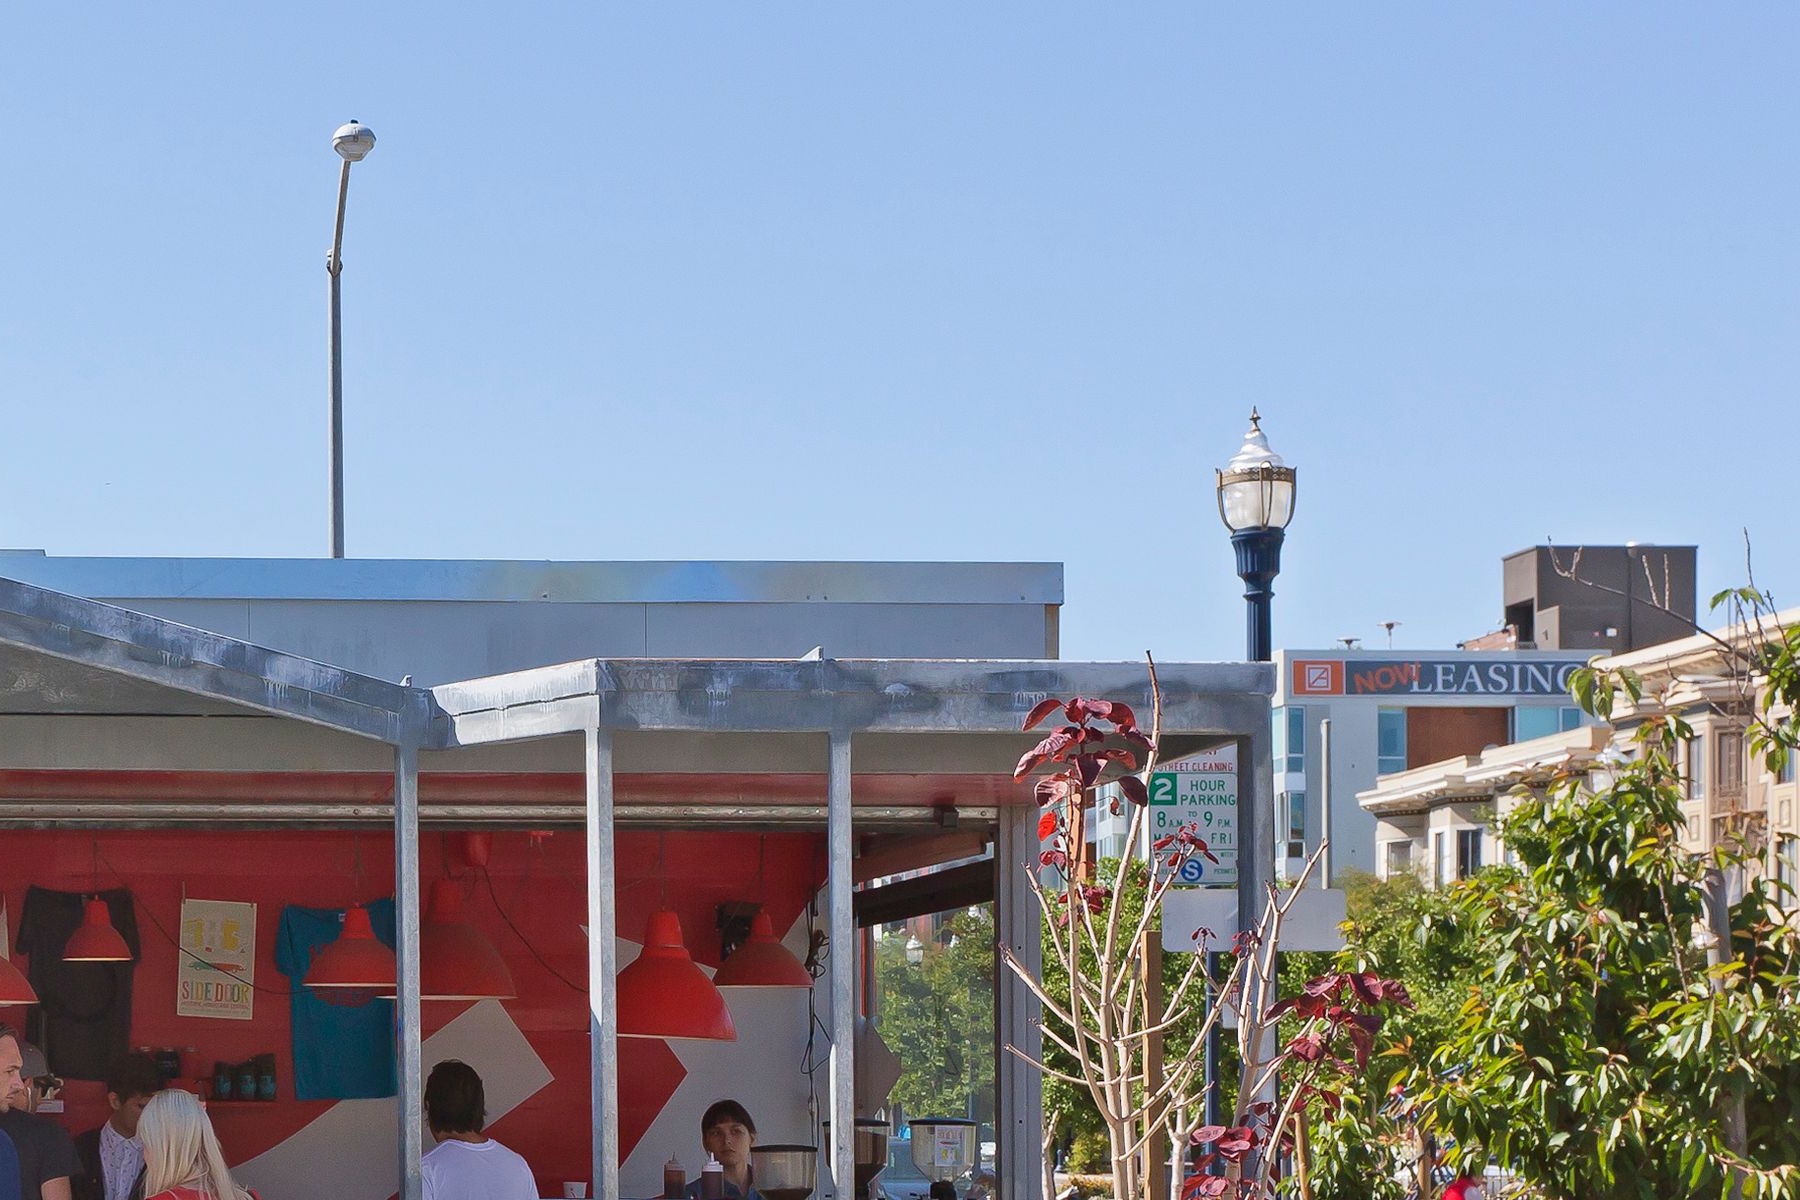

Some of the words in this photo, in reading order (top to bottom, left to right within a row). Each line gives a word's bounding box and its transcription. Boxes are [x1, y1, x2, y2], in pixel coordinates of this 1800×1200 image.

[1353, 661, 1421, 693] NOW
[1192, 762, 1233, 772] CLEANING
[1153, 777, 1173, 801] 2
[1190, 780, 1225, 791] HOUR
[1180, 795, 1236, 806] PARKING
[1157, 811, 1166, 828] 8
[1169, 819, 1183, 827] A.M
[1204, 811, 1213, 827] 9
[1211, 833, 1232, 844] FRI
[1184, 860, 1199, 878] S
[181, 981, 213, 1002] SIDE
[214, 983, 250, 1003] DOOR
